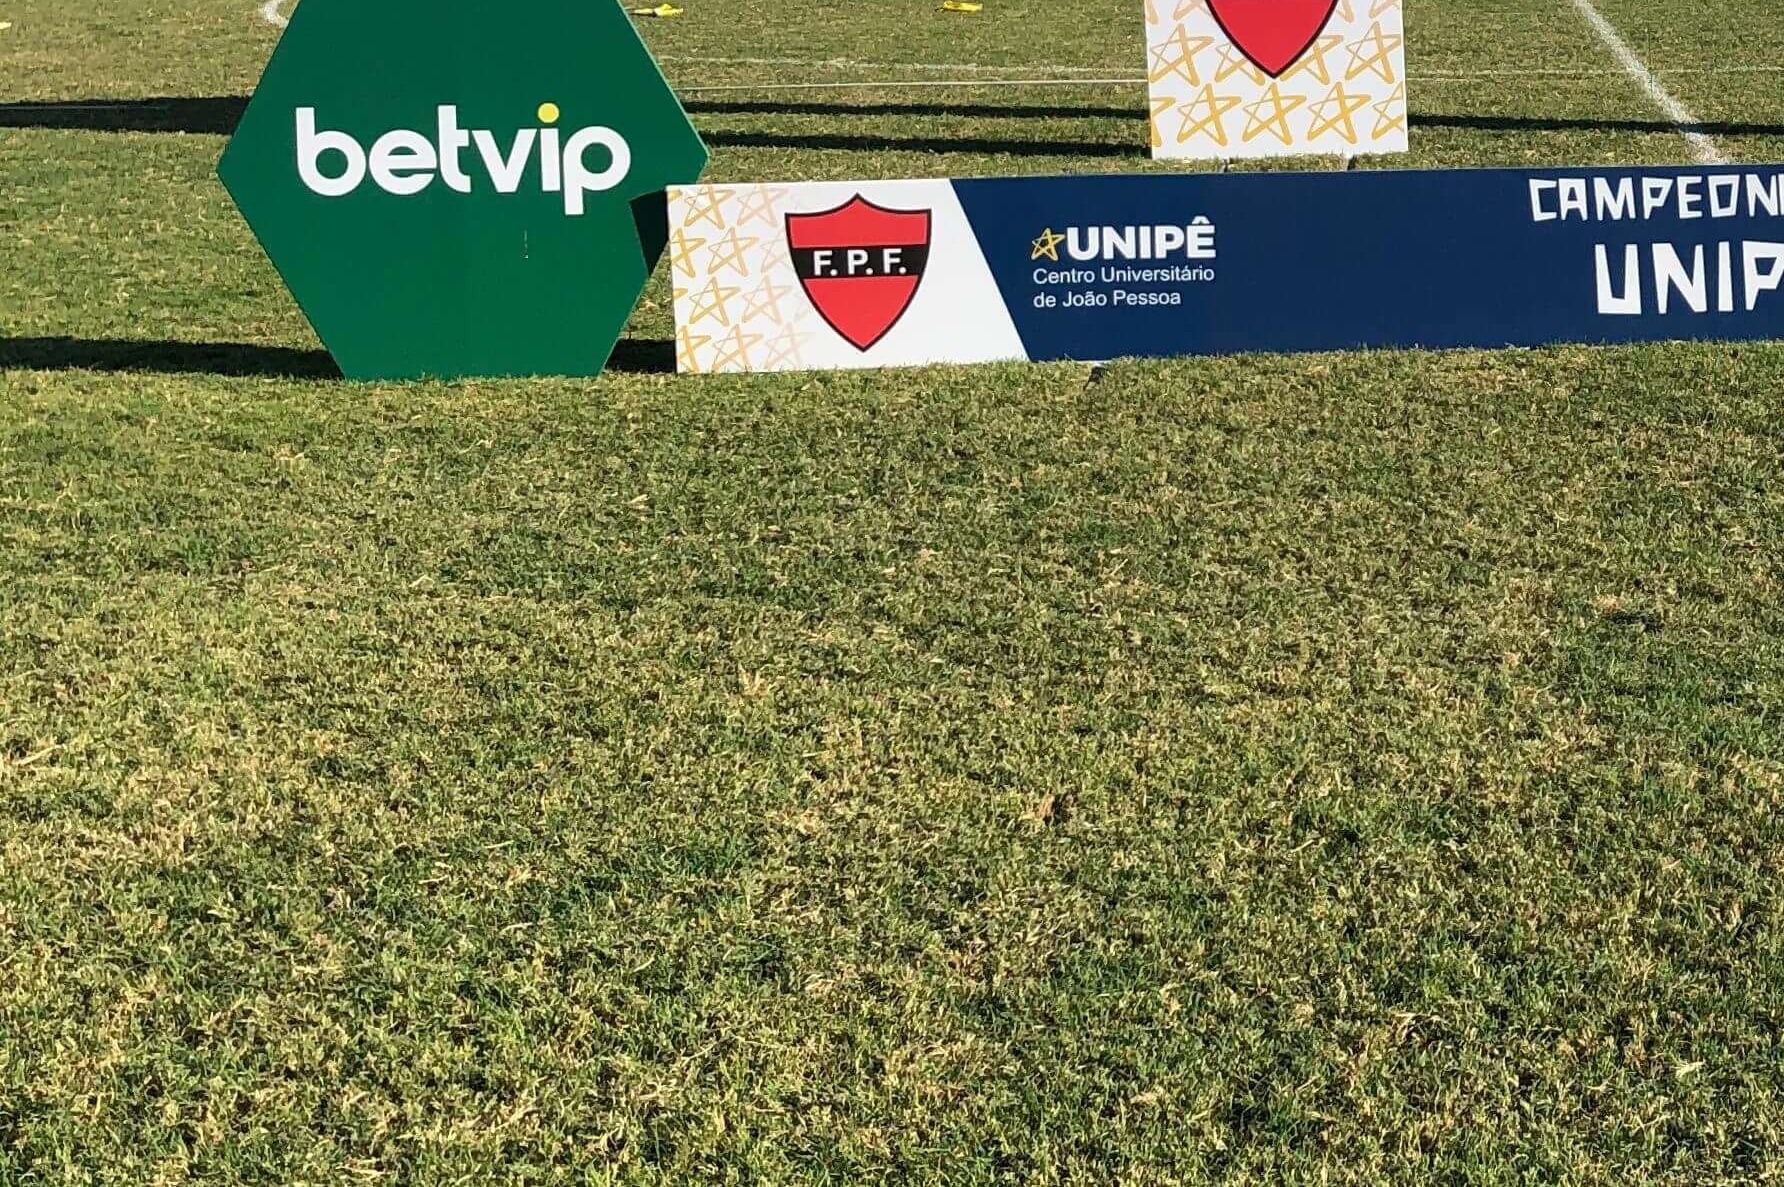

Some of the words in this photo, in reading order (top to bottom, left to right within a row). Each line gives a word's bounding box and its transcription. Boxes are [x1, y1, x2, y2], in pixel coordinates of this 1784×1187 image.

[295, 102, 631, 216] betvip
[1066, 215, 1217, 261] UNIPÊ
[1033, 266, 1096, 285] Centro
[1101, 264, 1216, 284] Universitário
[1033, 291, 1057, 308] de
[1062, 290, 1108, 308] João
[1113, 290, 1181, 307] Pessoa
